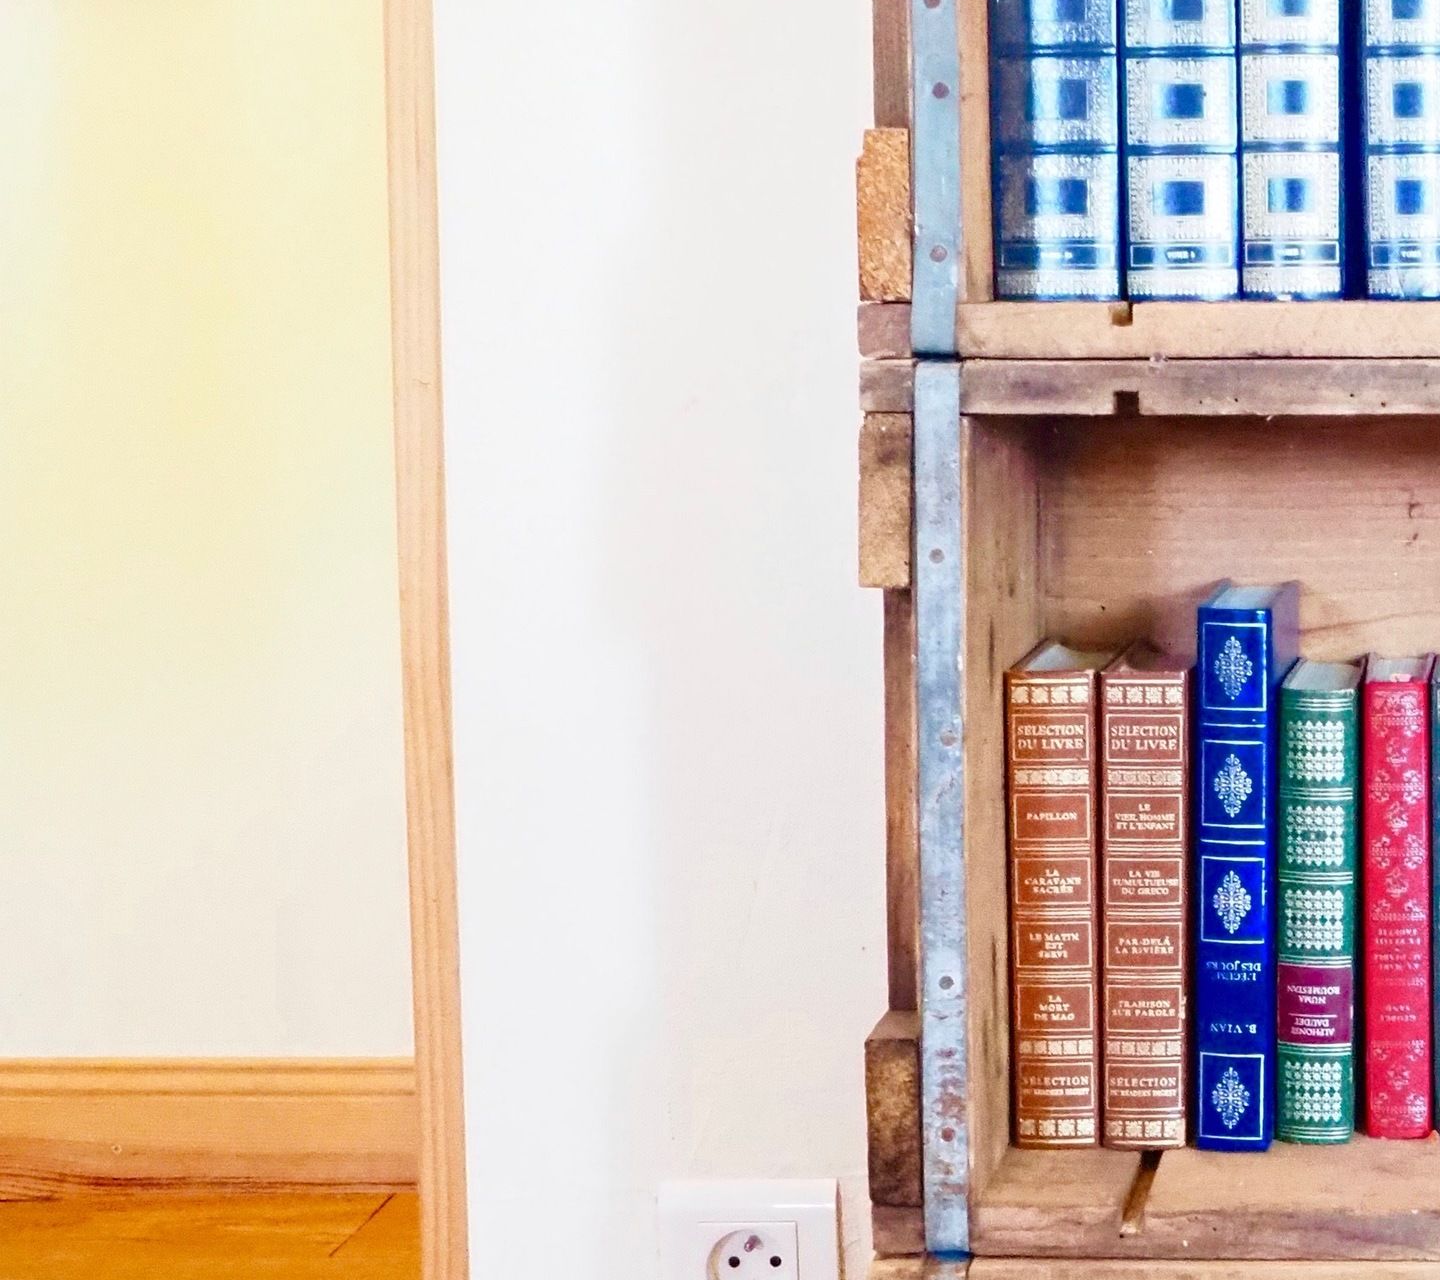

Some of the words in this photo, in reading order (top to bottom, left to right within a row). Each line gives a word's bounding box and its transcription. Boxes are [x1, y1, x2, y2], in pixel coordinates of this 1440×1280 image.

[1018, 739, 1037, 750] DU
[1042, 738, 1084, 750] LIVRE
[1112, 739, 1130, 750] DU
[1136, 738, 1178, 750] LIVRE
[1139, 803, 1151, 812] LE
[1116, 822, 1128, 830] ET
[1046, 869, 1060, 878] LA
[1129, 870, 1142, 878] LA
[1122, 886, 1136, 896] DU
[1030, 932, 1042, 942] LE
[1044, 932, 1080, 942] MATIN
[1045, 942, 1064, 950] EST
[1115, 946, 1128, 954] LA
[1241, 962, 1262, 972] DES
[1287, 985, 1340, 995] ROUMESTAN
[1048, 994, 1062, 1003] LA
[1298, 995, 1326, 1004] NUMA
[1040, 1004, 1070, 1012] MORT
[1034, 1013, 1048, 1021] DE
[1051, 1013, 1075, 1021] MAO
[1294, 1018, 1330, 1027] DAUDET
[1210, 1023, 1243, 1034] VIAN
[1245, 1024, 1257, 1034] B.
